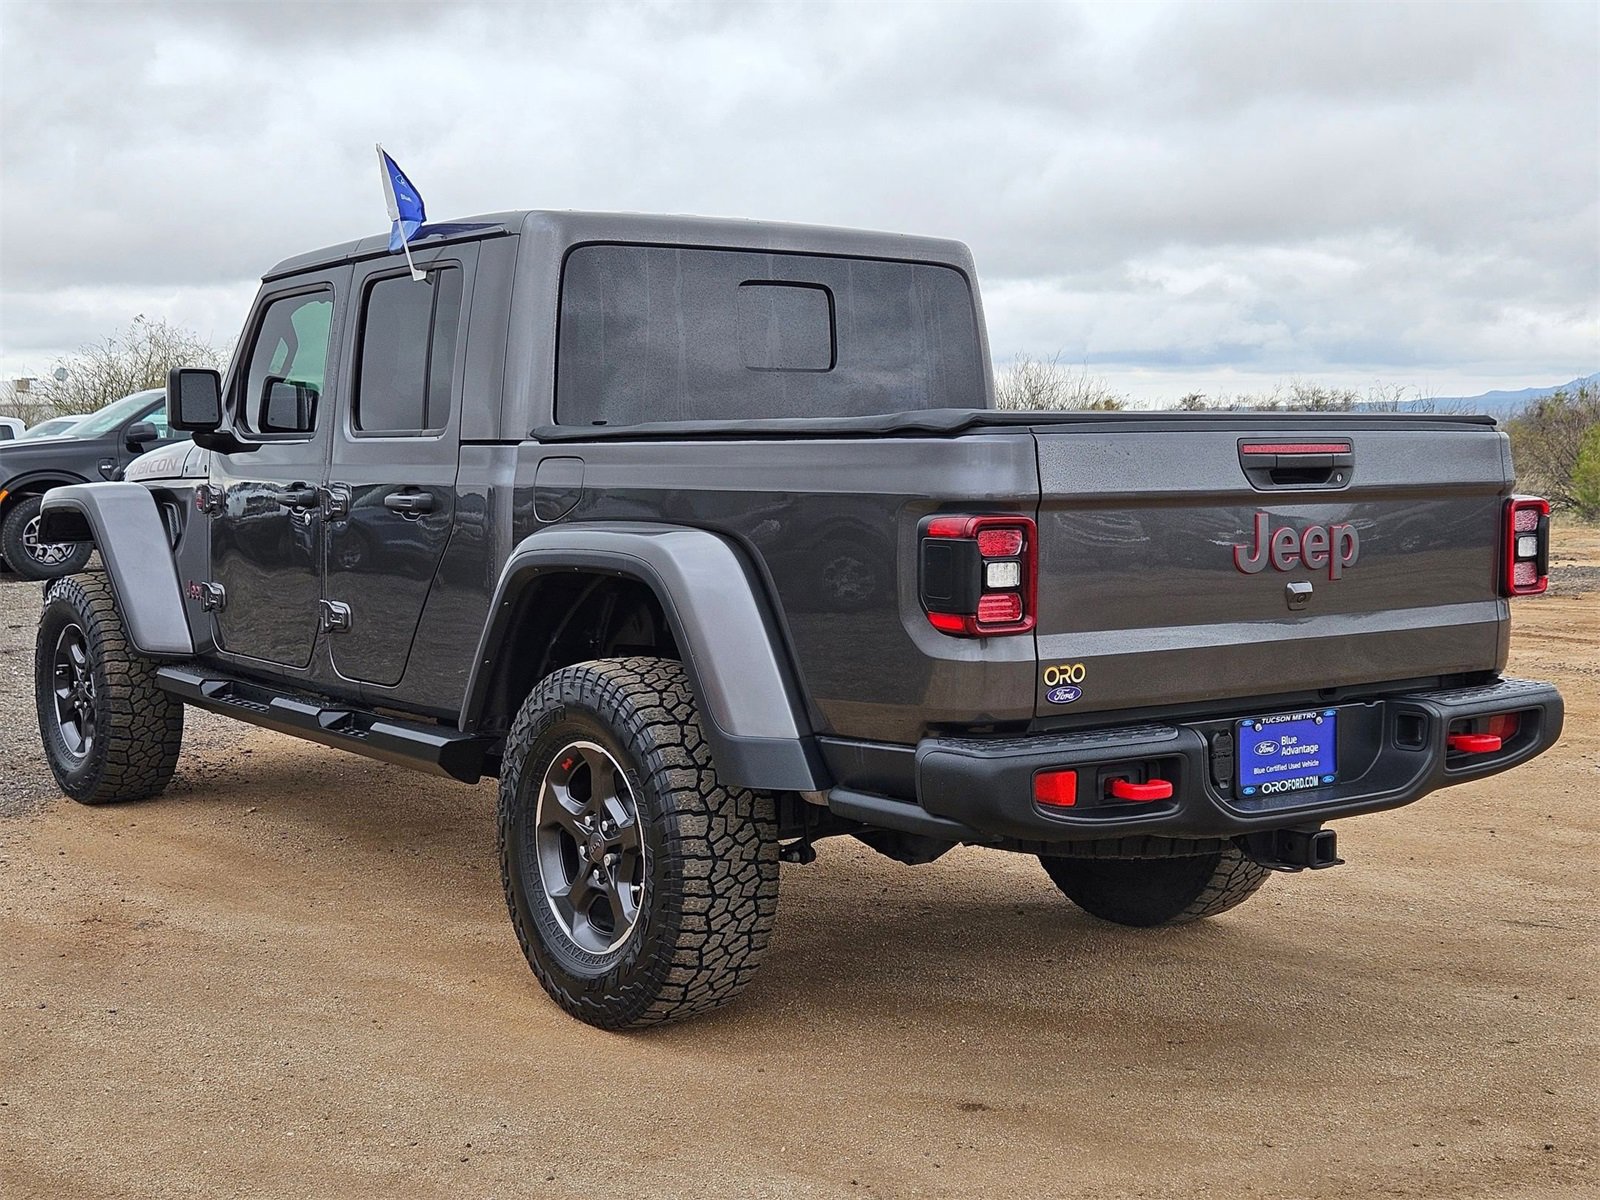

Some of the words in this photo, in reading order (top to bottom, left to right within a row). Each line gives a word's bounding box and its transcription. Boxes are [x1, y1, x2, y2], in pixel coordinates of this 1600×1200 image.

[128, 457, 178, 475] UBICON
[1233, 512, 1360, 581] Jeep
[1044, 663, 1086, 686] ORO
[1052, 688, 1077, 701] Ford
[1262, 715, 1291, 724] TUCSON
[1292, 712, 1317, 722] METRO
[1281, 736, 1297, 745] Blue
[1281, 744, 1319, 756] Advantage
[1253, 767, 1265, 775] Blue
[1266, 764, 1287, 773] Certified
[1288, 762, 1301, 770] Used
[1302, 760, 1320, 768] Vehicle
[1262, 776, 1319, 794] OROFORD.COM
